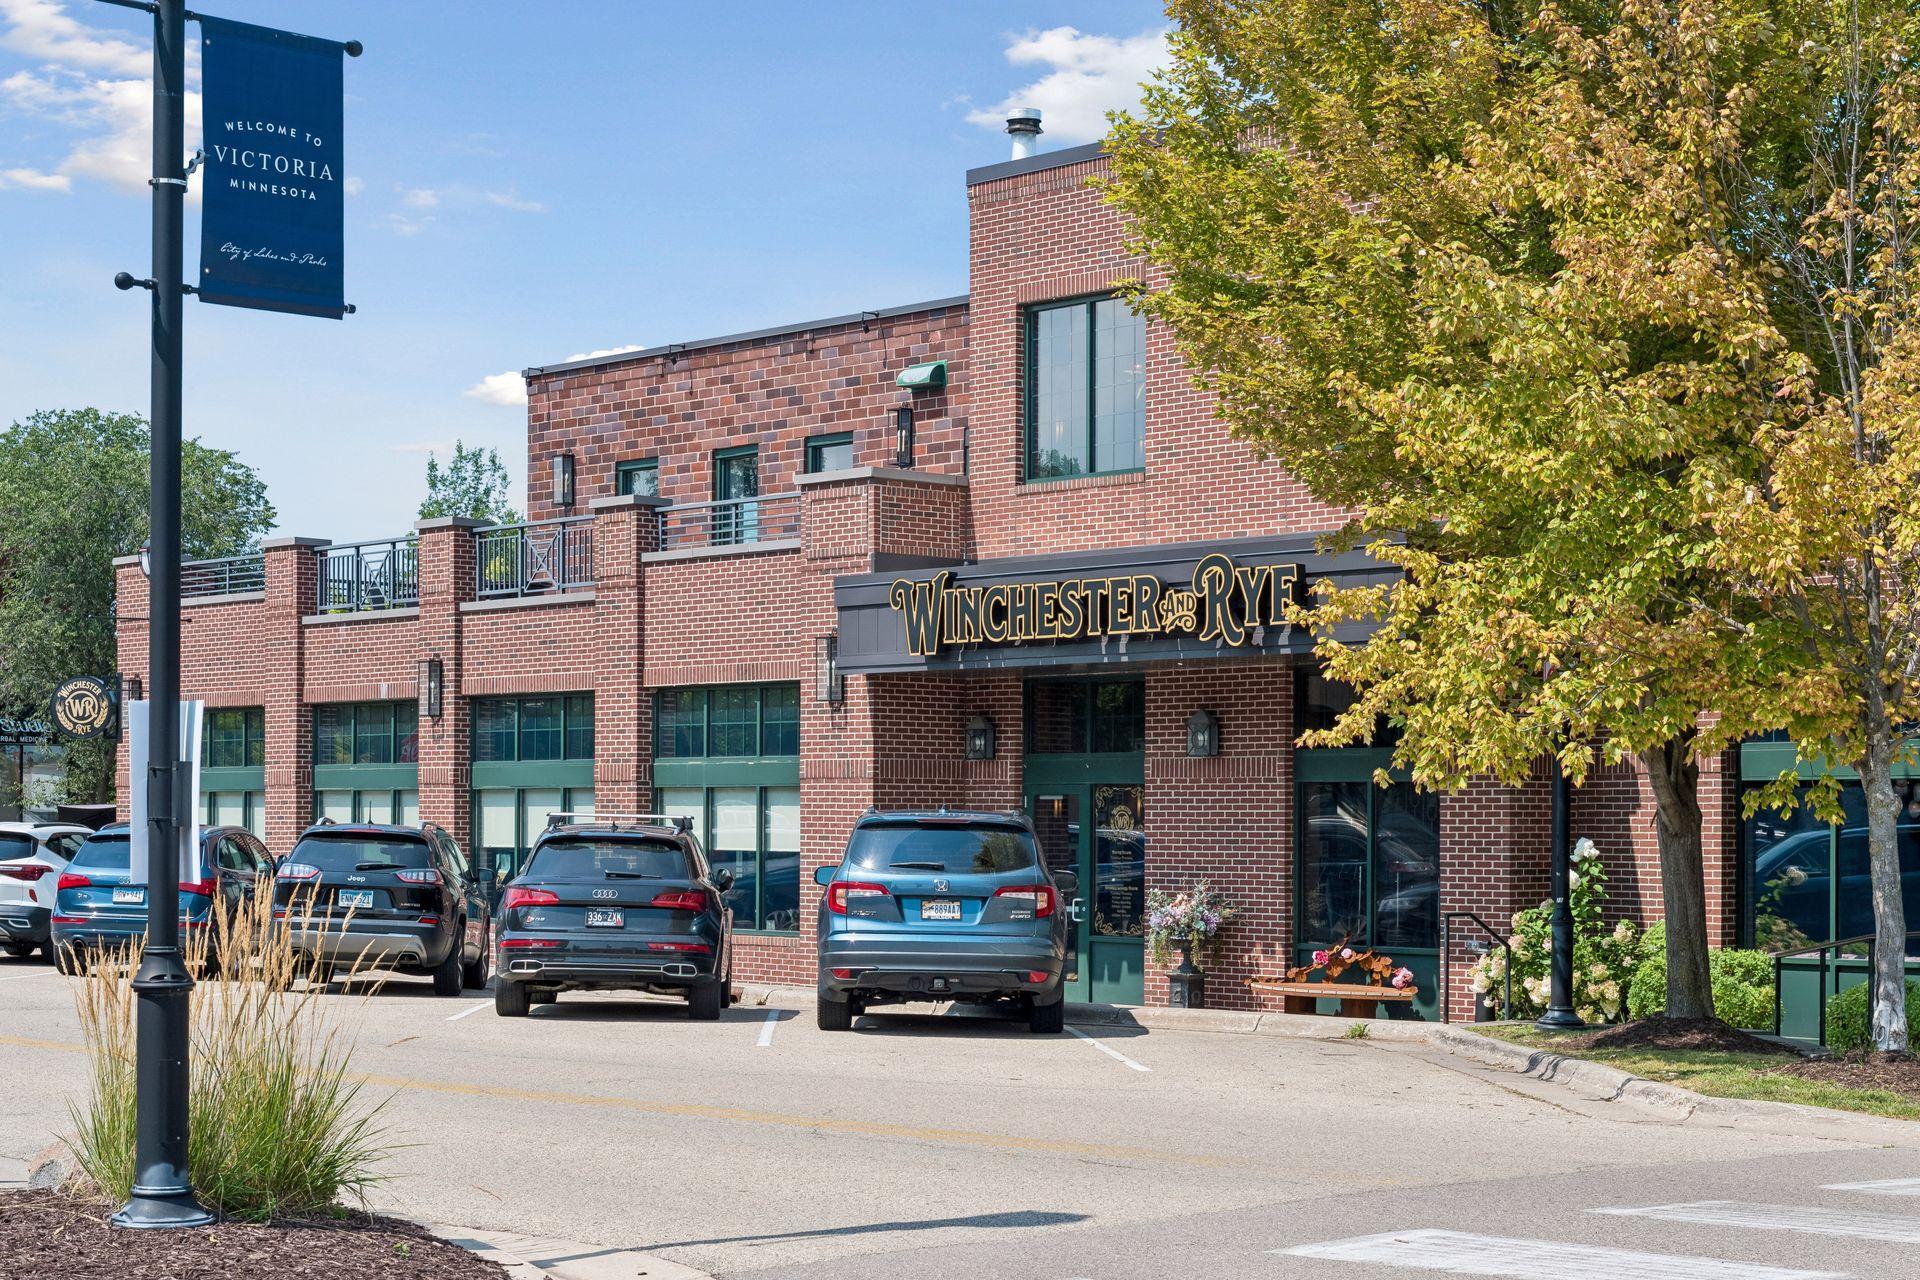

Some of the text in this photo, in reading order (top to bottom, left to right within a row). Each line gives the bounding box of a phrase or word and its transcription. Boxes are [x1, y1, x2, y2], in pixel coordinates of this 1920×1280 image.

[225, 121, 322, 146] WELCOME TO
[214, 145, 333, 181] VICTORIA
[230, 178, 316, 200] MINNESOTA
[220, 242, 240, 260] City
[889, 554, 1298, 656] WINCHESTER AND RYE
[58, 681, 101, 698] WINCHESTER
[65, 697, 98, 718] WR
[347, 875, 365, 883] Jeep
[588, 912, 622, 922] 336 ZXK
